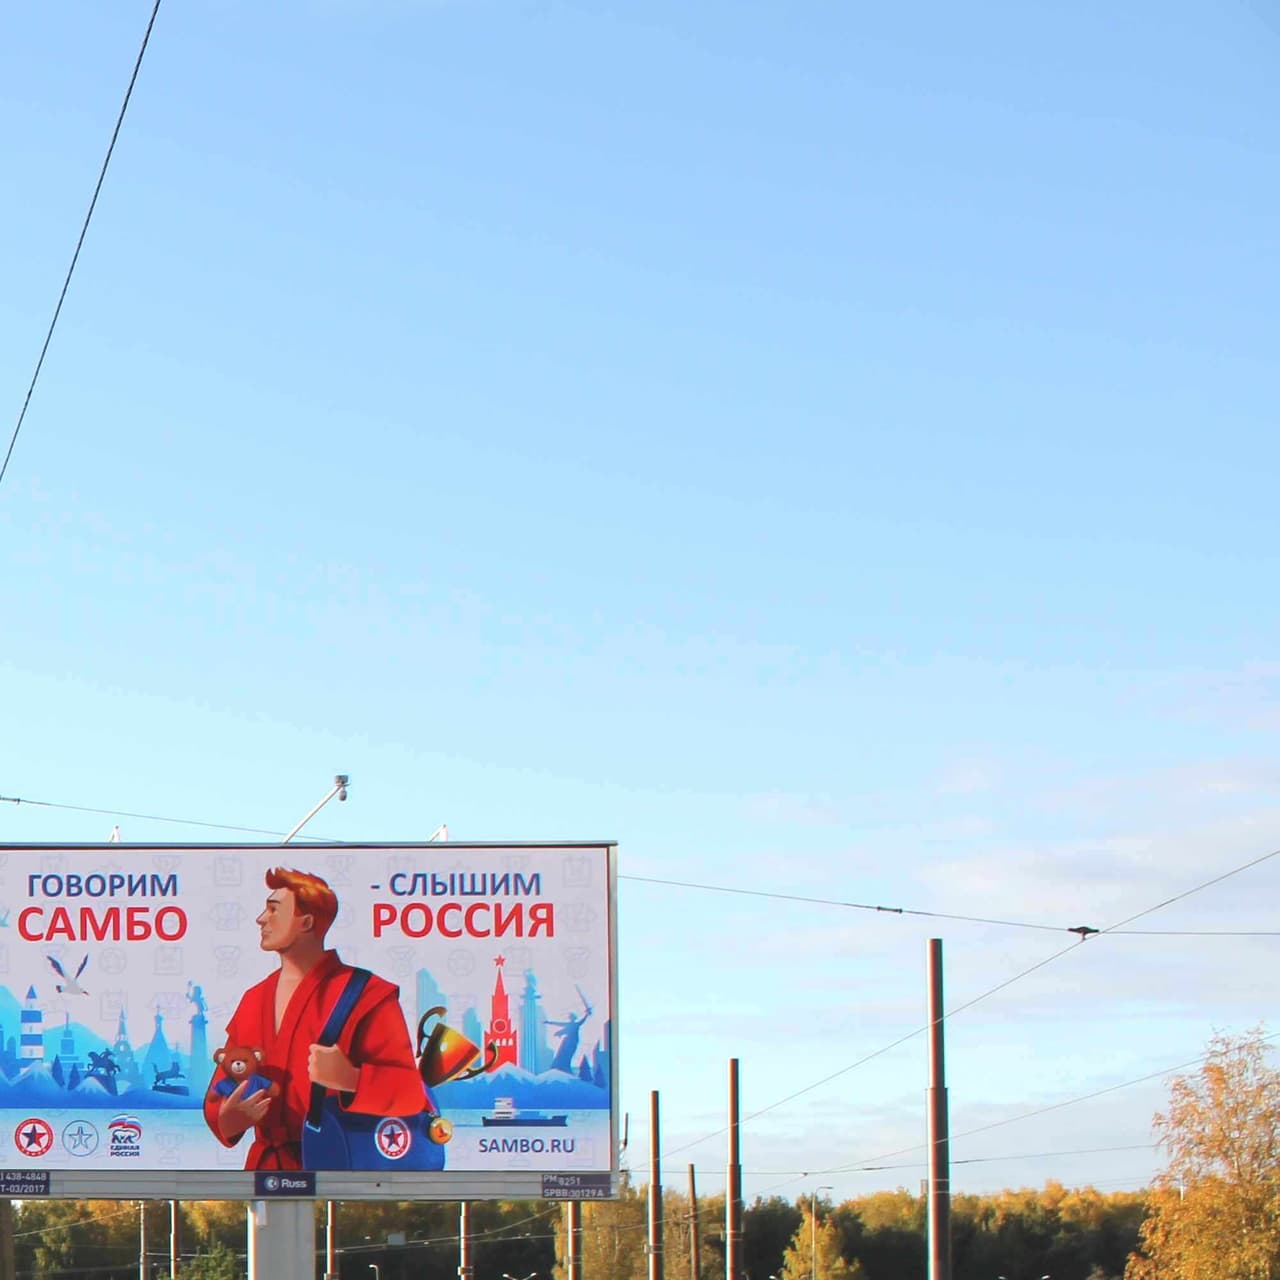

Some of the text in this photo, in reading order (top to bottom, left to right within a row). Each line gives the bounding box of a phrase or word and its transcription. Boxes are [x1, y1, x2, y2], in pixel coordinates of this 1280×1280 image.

[28, 873, 177, 898] ГОВОРИМ
[390, 872, 541, 897] СЛЫШИМ
[17, 905, 188, 942] САМБО
[372, 902, 555, 939] РОССИЯ
[479, 1138, 575, 1153] SAMBO.RU
[281, 1178, 308, 1189] Russ
